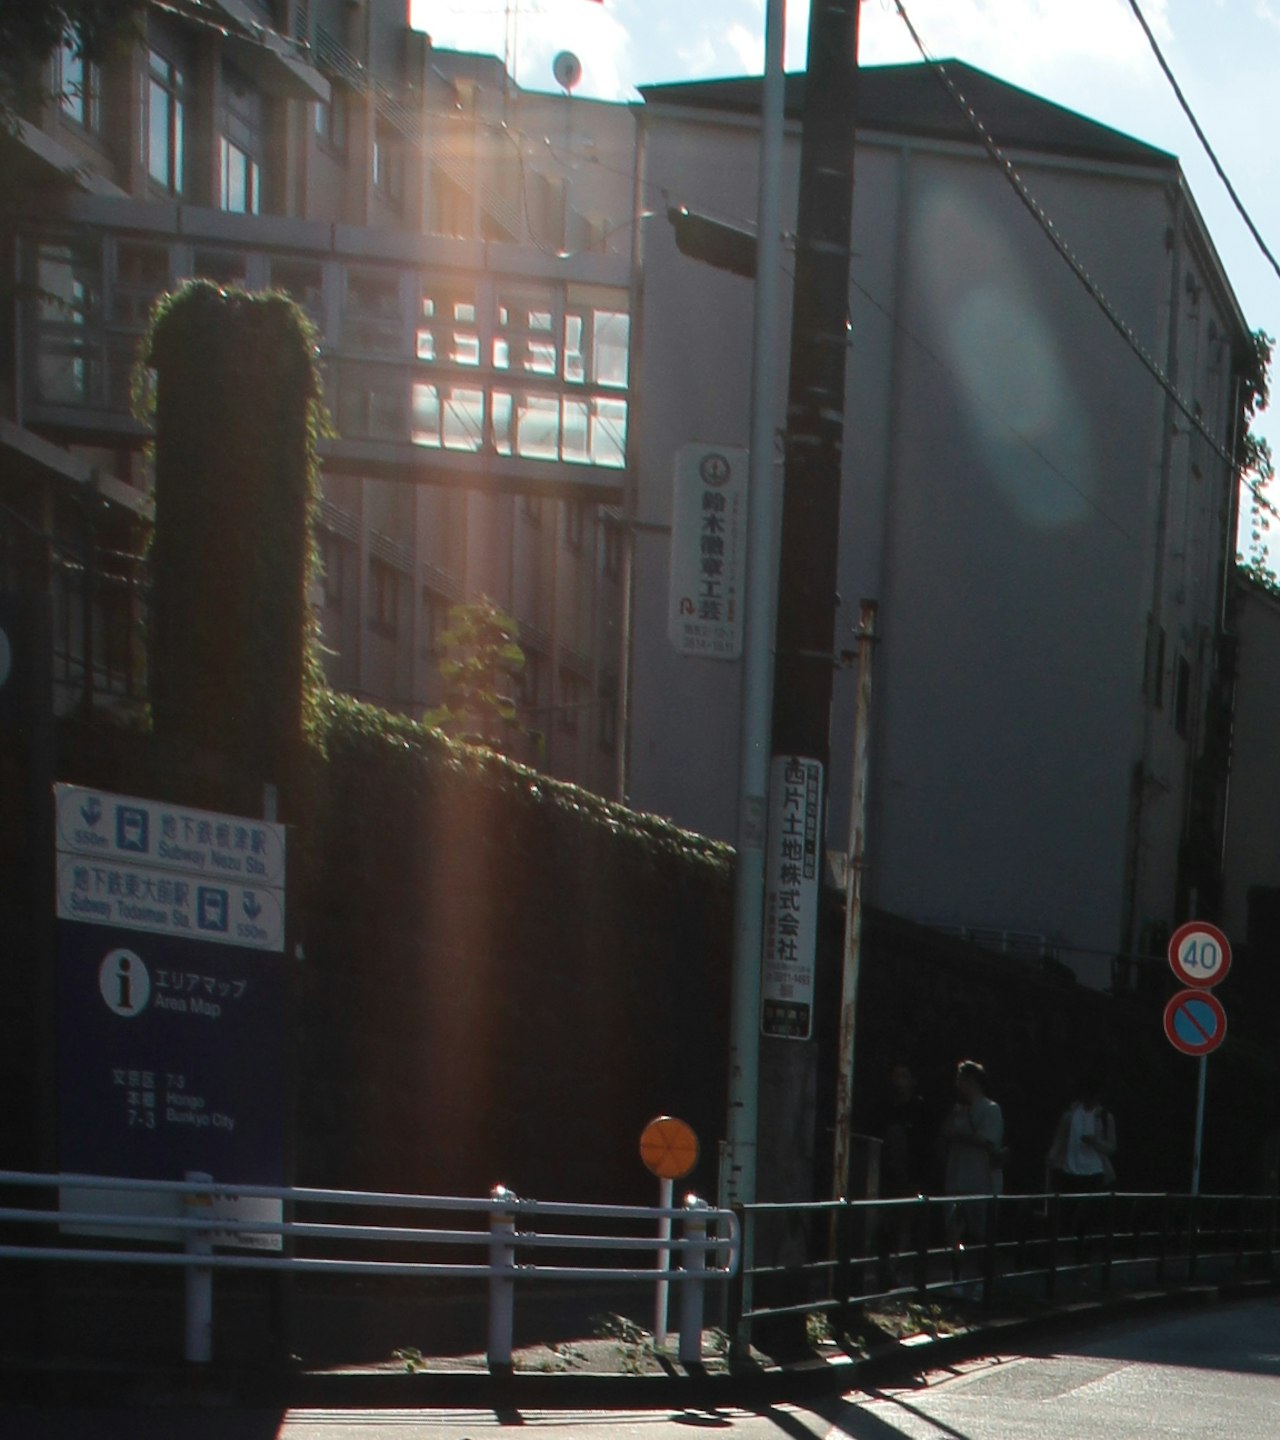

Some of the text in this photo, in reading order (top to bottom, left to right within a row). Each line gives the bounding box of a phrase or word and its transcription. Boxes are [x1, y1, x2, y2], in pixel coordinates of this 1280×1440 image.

[160, 813, 267, 856] 地下鉄根津駅
[159, 840, 206, 869] Subway
[777, 757, 805, 962] 西片土地株式会社
[73, 866, 190, 910] 地下鉄東大前駅
[70, 892, 111, 918] Subway
[1183, 939, 1217, 970] 40
[154, 968, 248, 998] エリアマップ
[154, 992, 222, 1019] Area Map
[112, 1067, 155, 1089] 文京区
[164, 1091, 206, 1110] Hongo
[127, 1109, 155, 1130] 7-3
[164, 1107, 236, 1131] Bunkyo City
